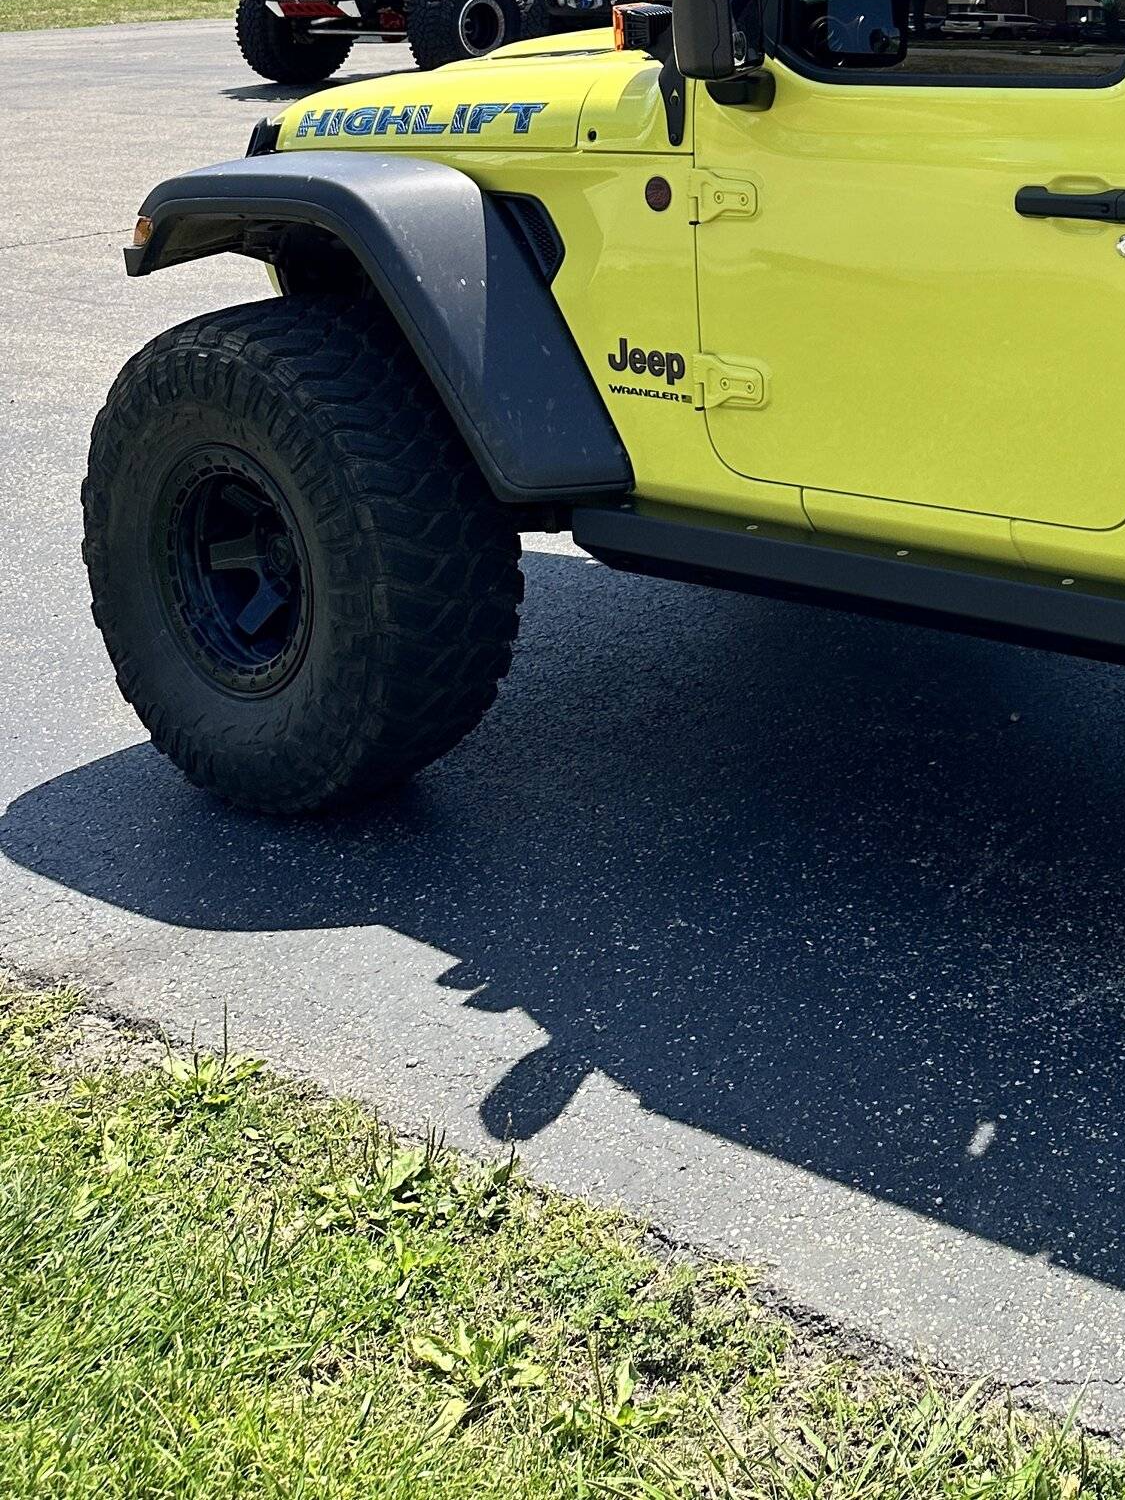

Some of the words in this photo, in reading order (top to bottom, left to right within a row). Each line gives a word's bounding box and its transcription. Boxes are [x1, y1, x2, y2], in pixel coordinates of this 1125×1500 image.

[297, 102, 549, 136] HIGHLIFT
[607, 337, 686, 386] Jeep
[608, 383, 680, 403] WRANGLER
